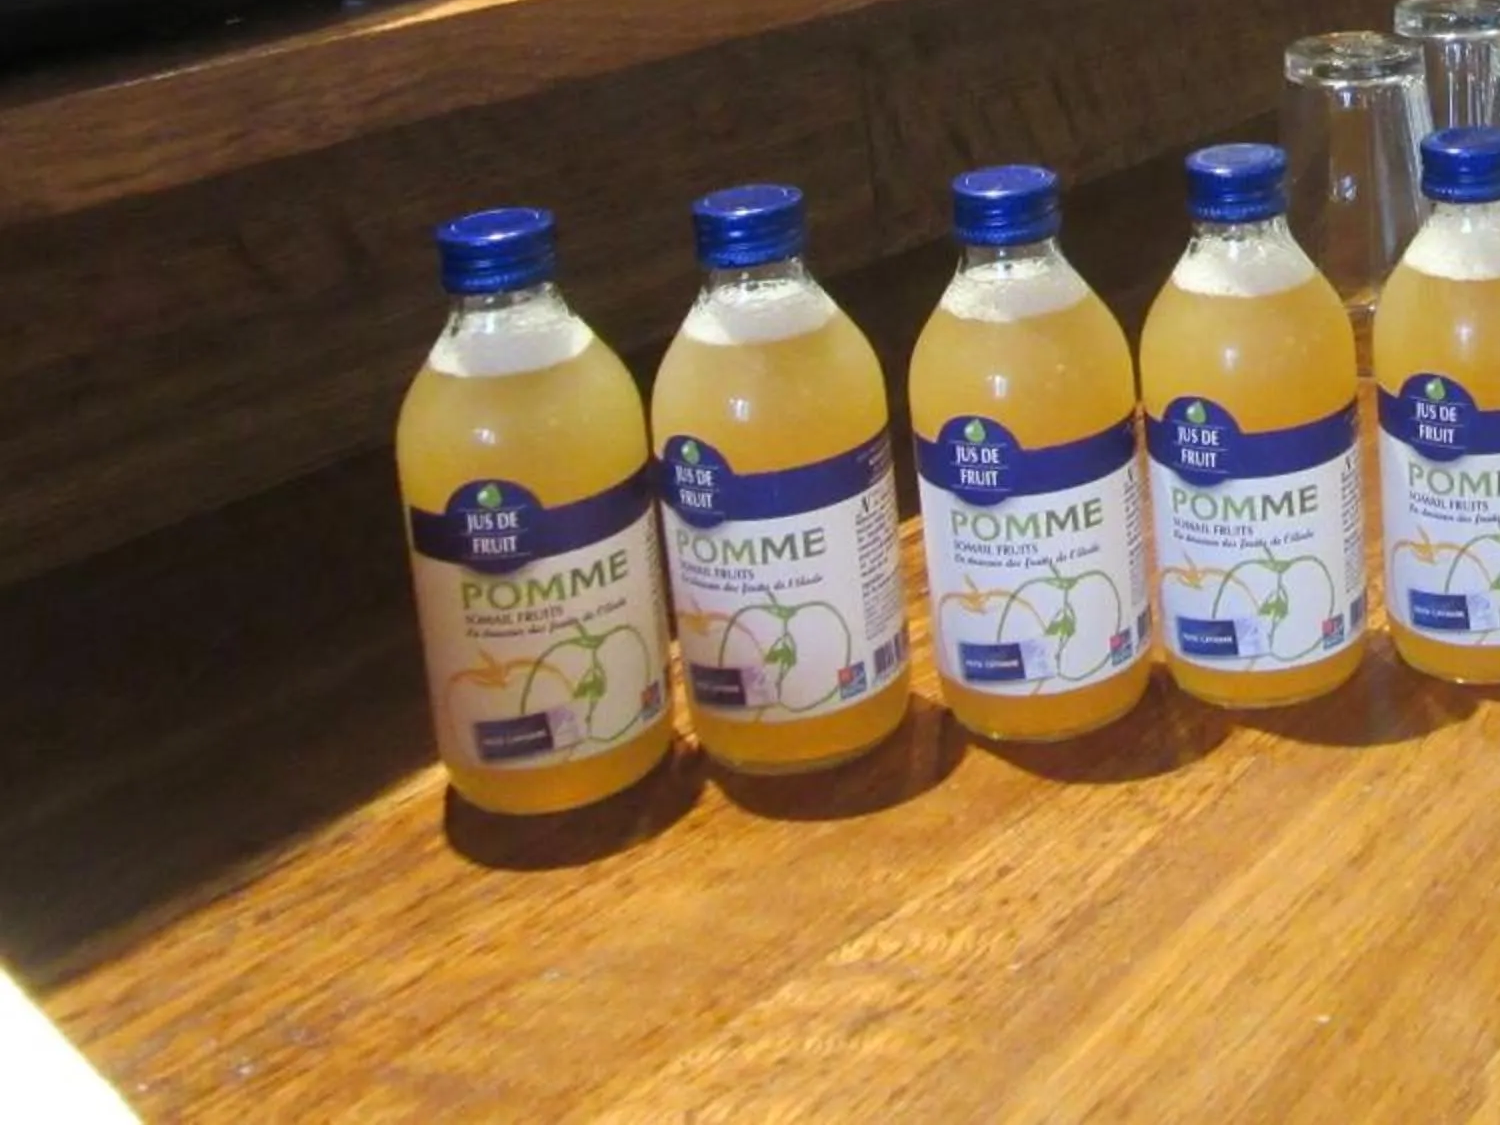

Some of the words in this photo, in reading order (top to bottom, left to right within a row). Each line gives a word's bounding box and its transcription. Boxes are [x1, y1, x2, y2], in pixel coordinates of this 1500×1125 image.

[1416, 402, 1437, 421] JUS
[1439, 405, 1458, 422] DE
[1177, 426, 1198, 445] JUS
[1201, 430, 1220, 446] DE
[1418, 424, 1454, 444] FRUIT
[956, 445, 978, 465] JUS
[981, 447, 1000, 464] DE
[1181, 448, 1218, 468] FRUIT
[960, 469, 999, 487] FRUIT
[1171, 483, 1319, 522] POMME
[466, 512, 494, 532] JUS
[496, 511, 519, 530] DE
[950, 497, 1104, 541] POMME
[472, 536, 518, 554] FRUIT
[675, 526, 828, 566] POMME
[460, 549, 630, 610] POMME
